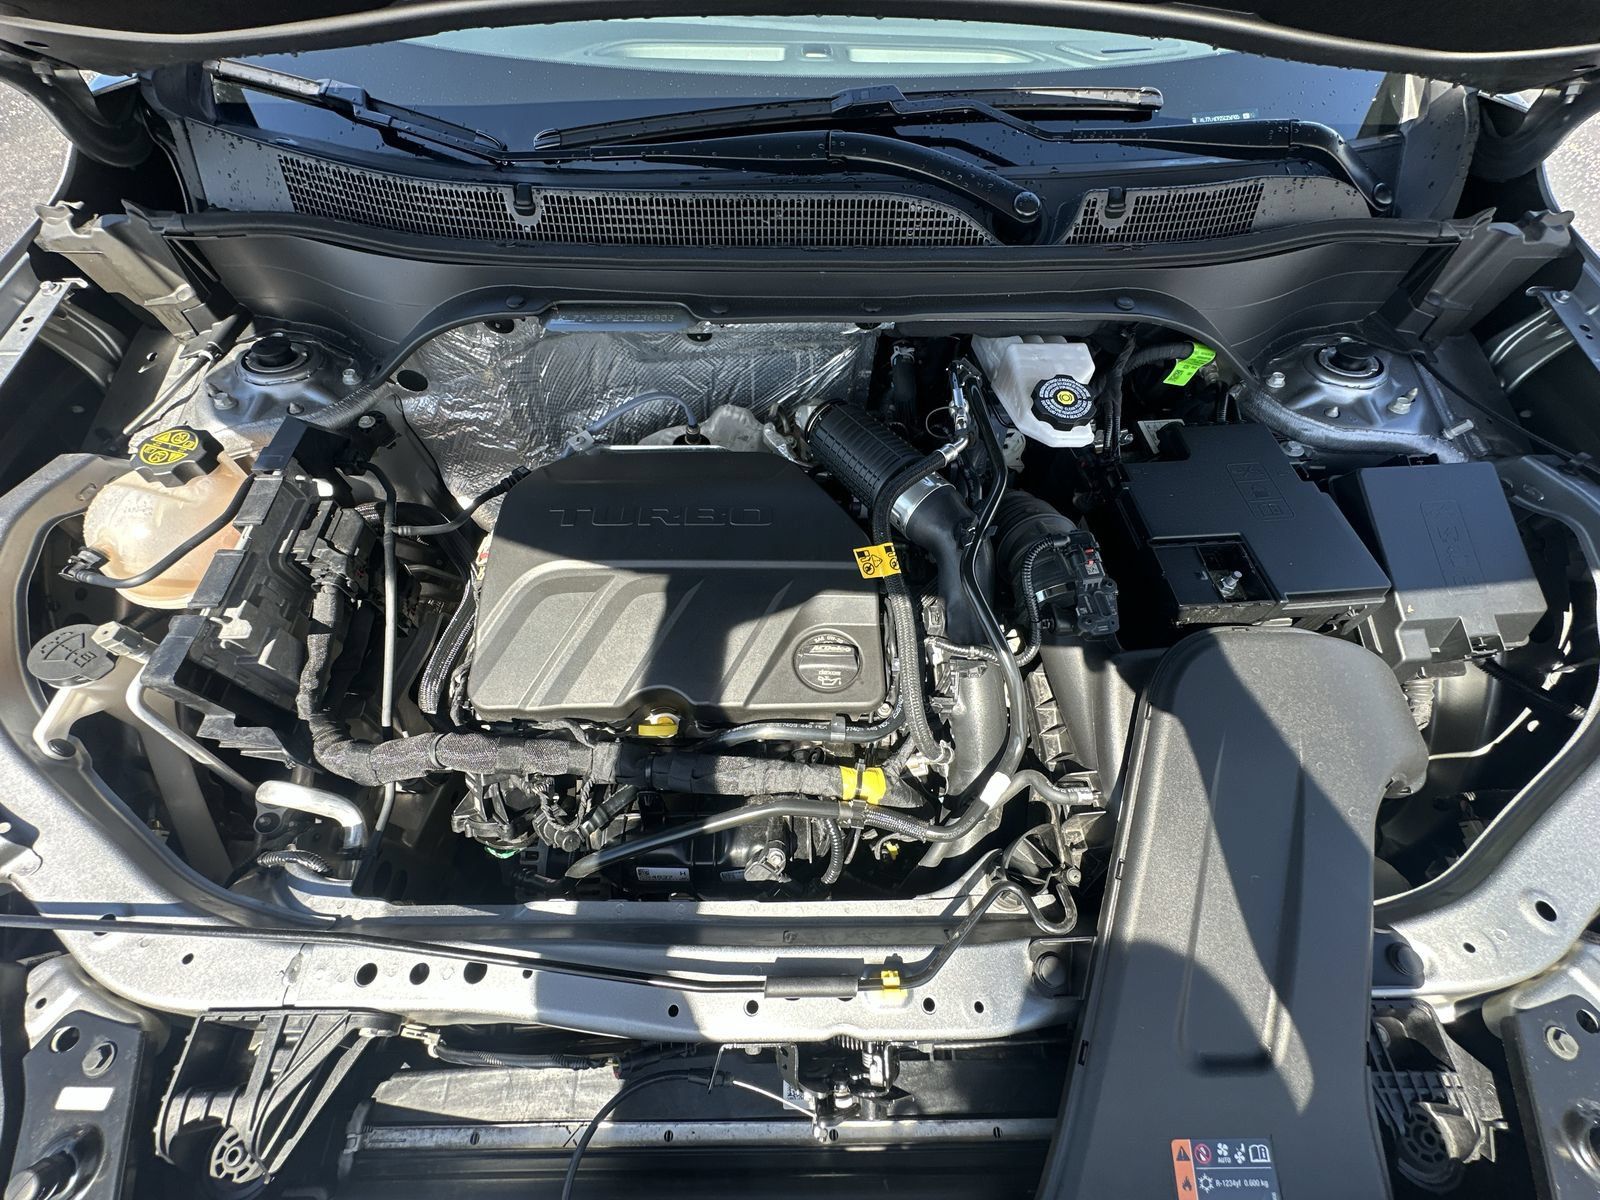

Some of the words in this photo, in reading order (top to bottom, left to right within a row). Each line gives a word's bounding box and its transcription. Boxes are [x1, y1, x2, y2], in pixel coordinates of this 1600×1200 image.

[548, 506, 774, 527] TURBO
[809, 645, 852, 654] ACDelco
[1261, 1180, 1269, 1189] kg
